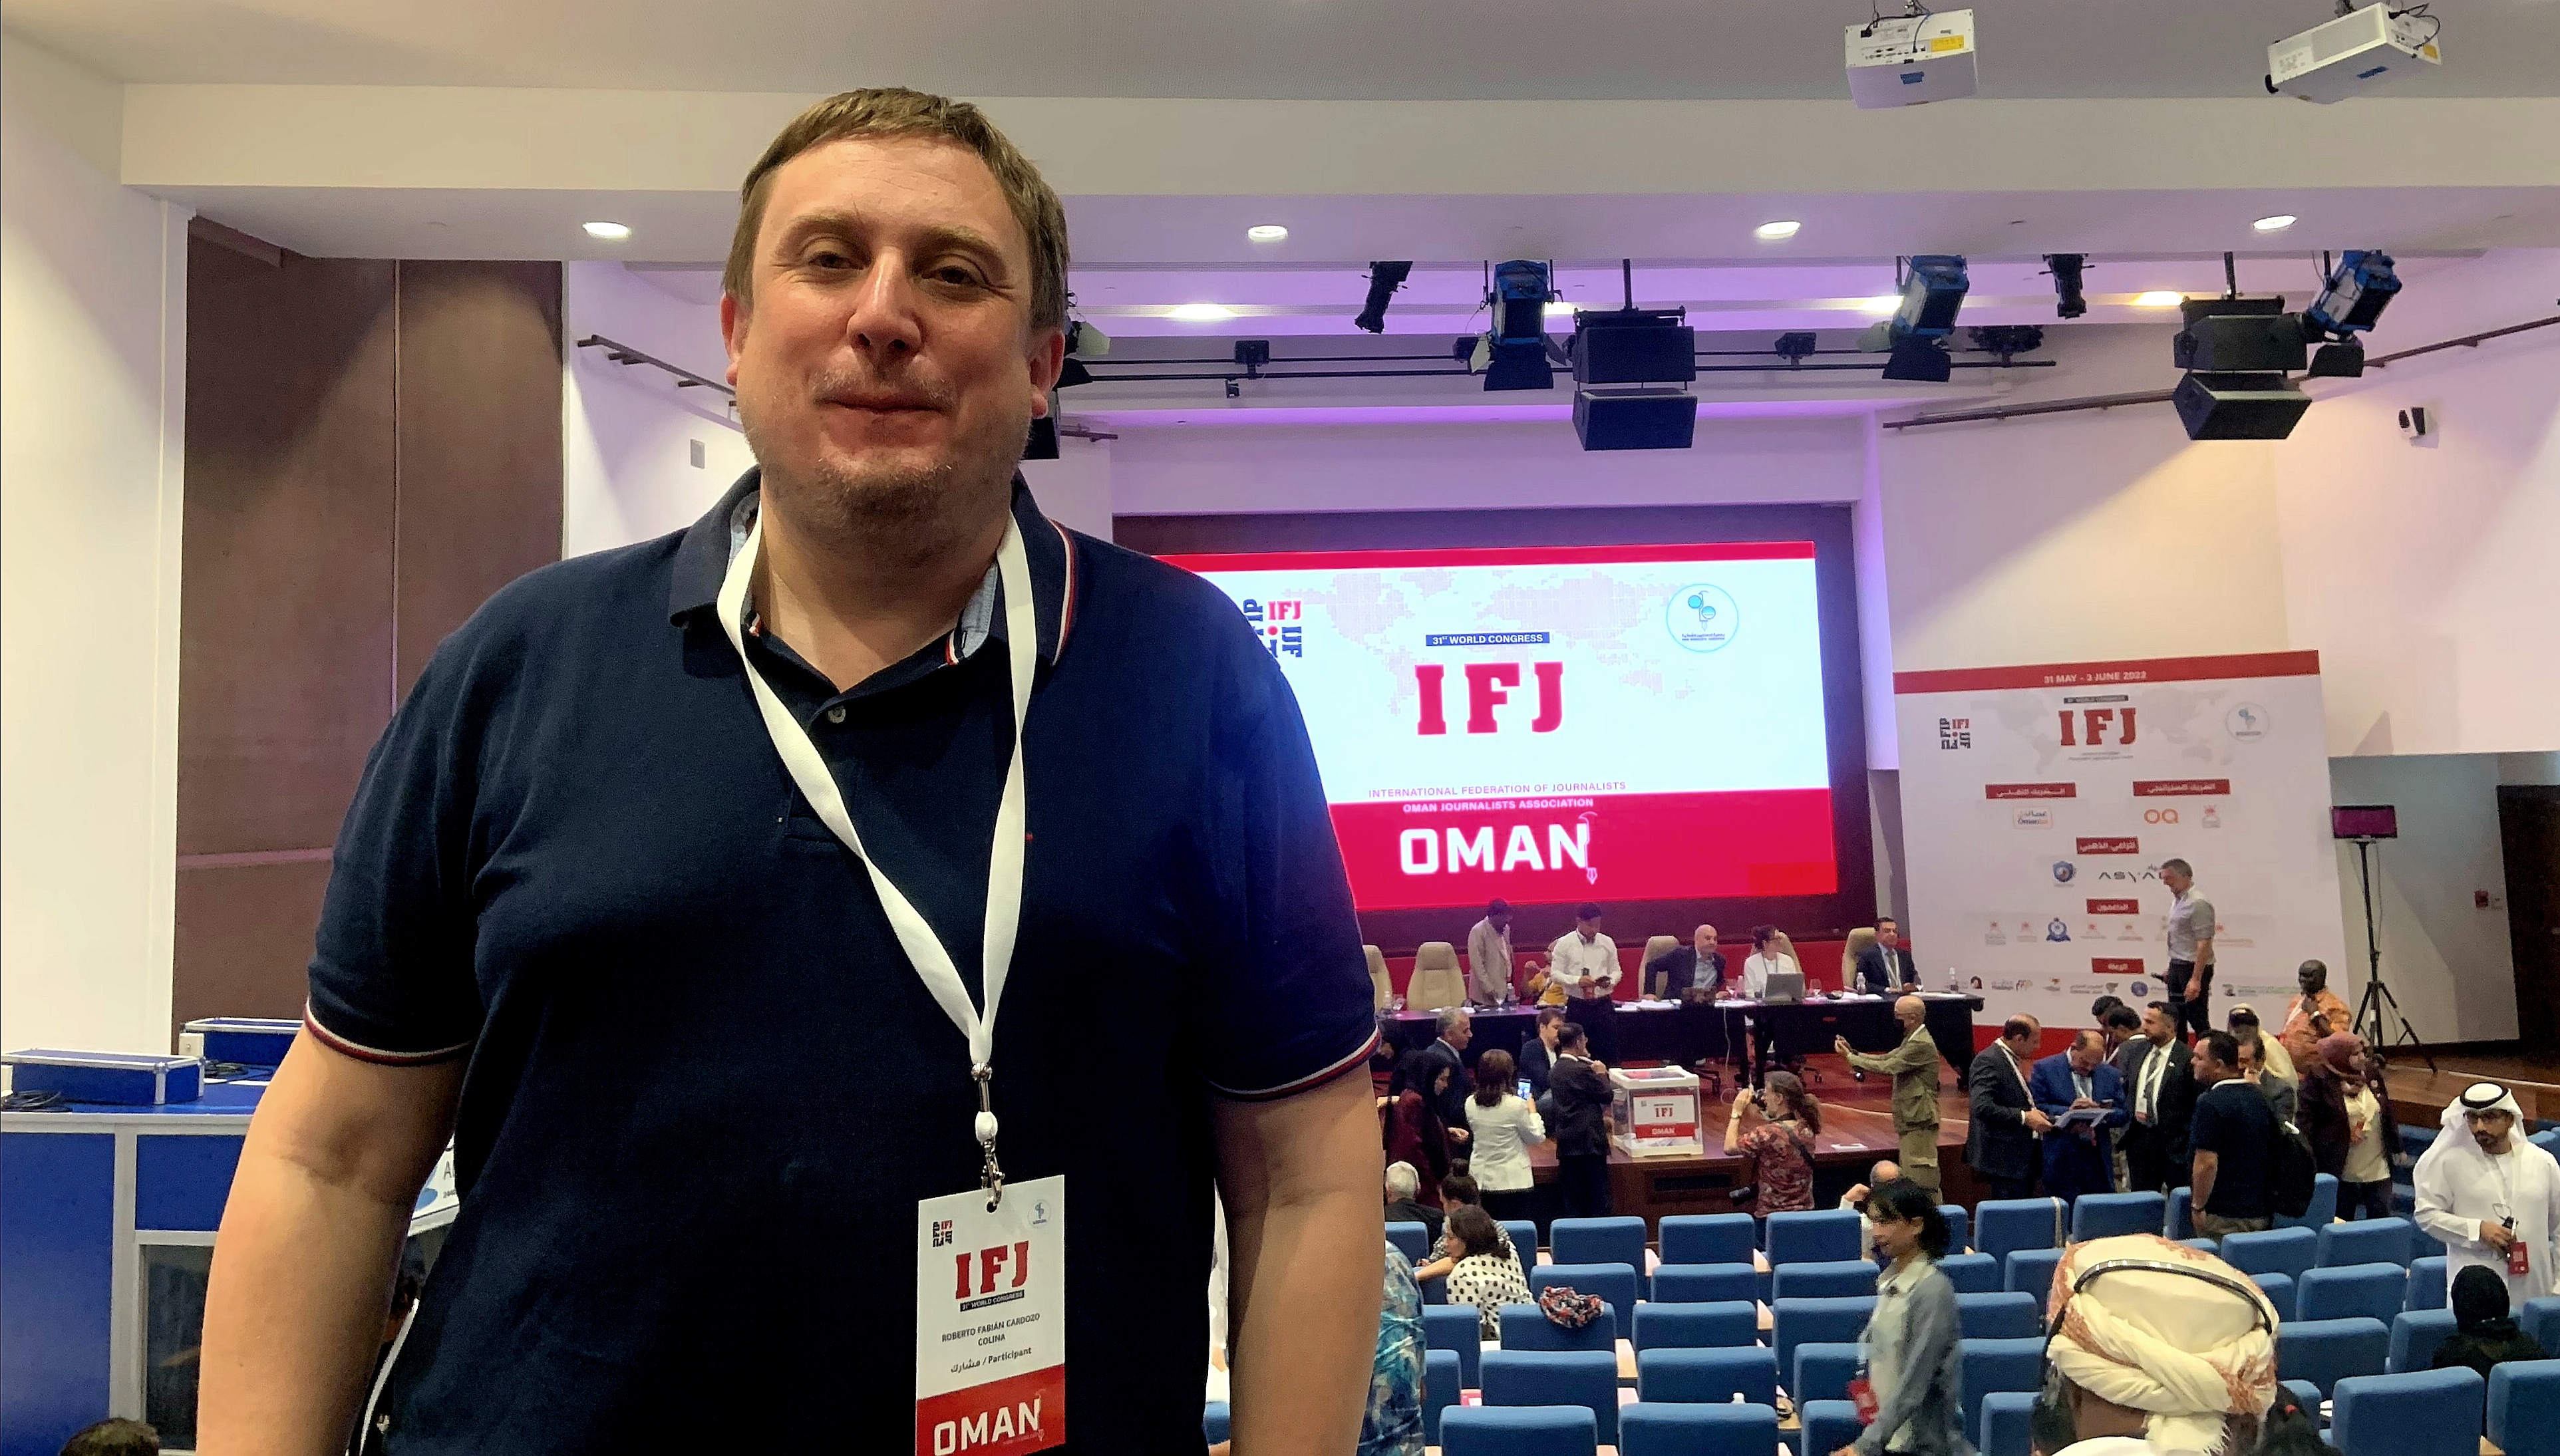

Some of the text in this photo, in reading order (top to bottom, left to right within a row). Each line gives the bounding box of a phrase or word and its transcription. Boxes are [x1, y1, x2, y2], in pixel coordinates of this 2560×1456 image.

[1268, 601, 1301, 620] IFJ
[1449, 635, 1486, 645] WORLD
[1488, 634, 1543, 643] CONGRESS
[2056, 674, 2077, 682] MAY
[2096, 672, 2120, 681] JUNE
[1415, 660, 1563, 736] IFJ
[2058, 708, 2136, 746] IFJ
[1368, 782, 1626, 798] INTERNATIONAL FEDERATION OF JOURNALISTS
[1403, 798, 1593, 813] OMAN JOURNALISTS ASSOCIATION
[2144, 808, 2179, 823] OQ
[1400, 823, 1587, 874] OMAN
[955, 1240, 1029, 1300] IFJ
[971, 1298, 992, 1308] WORLD
[993, 1292, 1023, 1303] CONGRESS
[942, 1313, 1040, 1343] ROBERTO FABIÁN CARDOZO
[978, 1334, 1005, 1346] COLINA
[988, 1347, 1032, 1364] Participant
[934, 1397, 1040, 1456] OMAN
